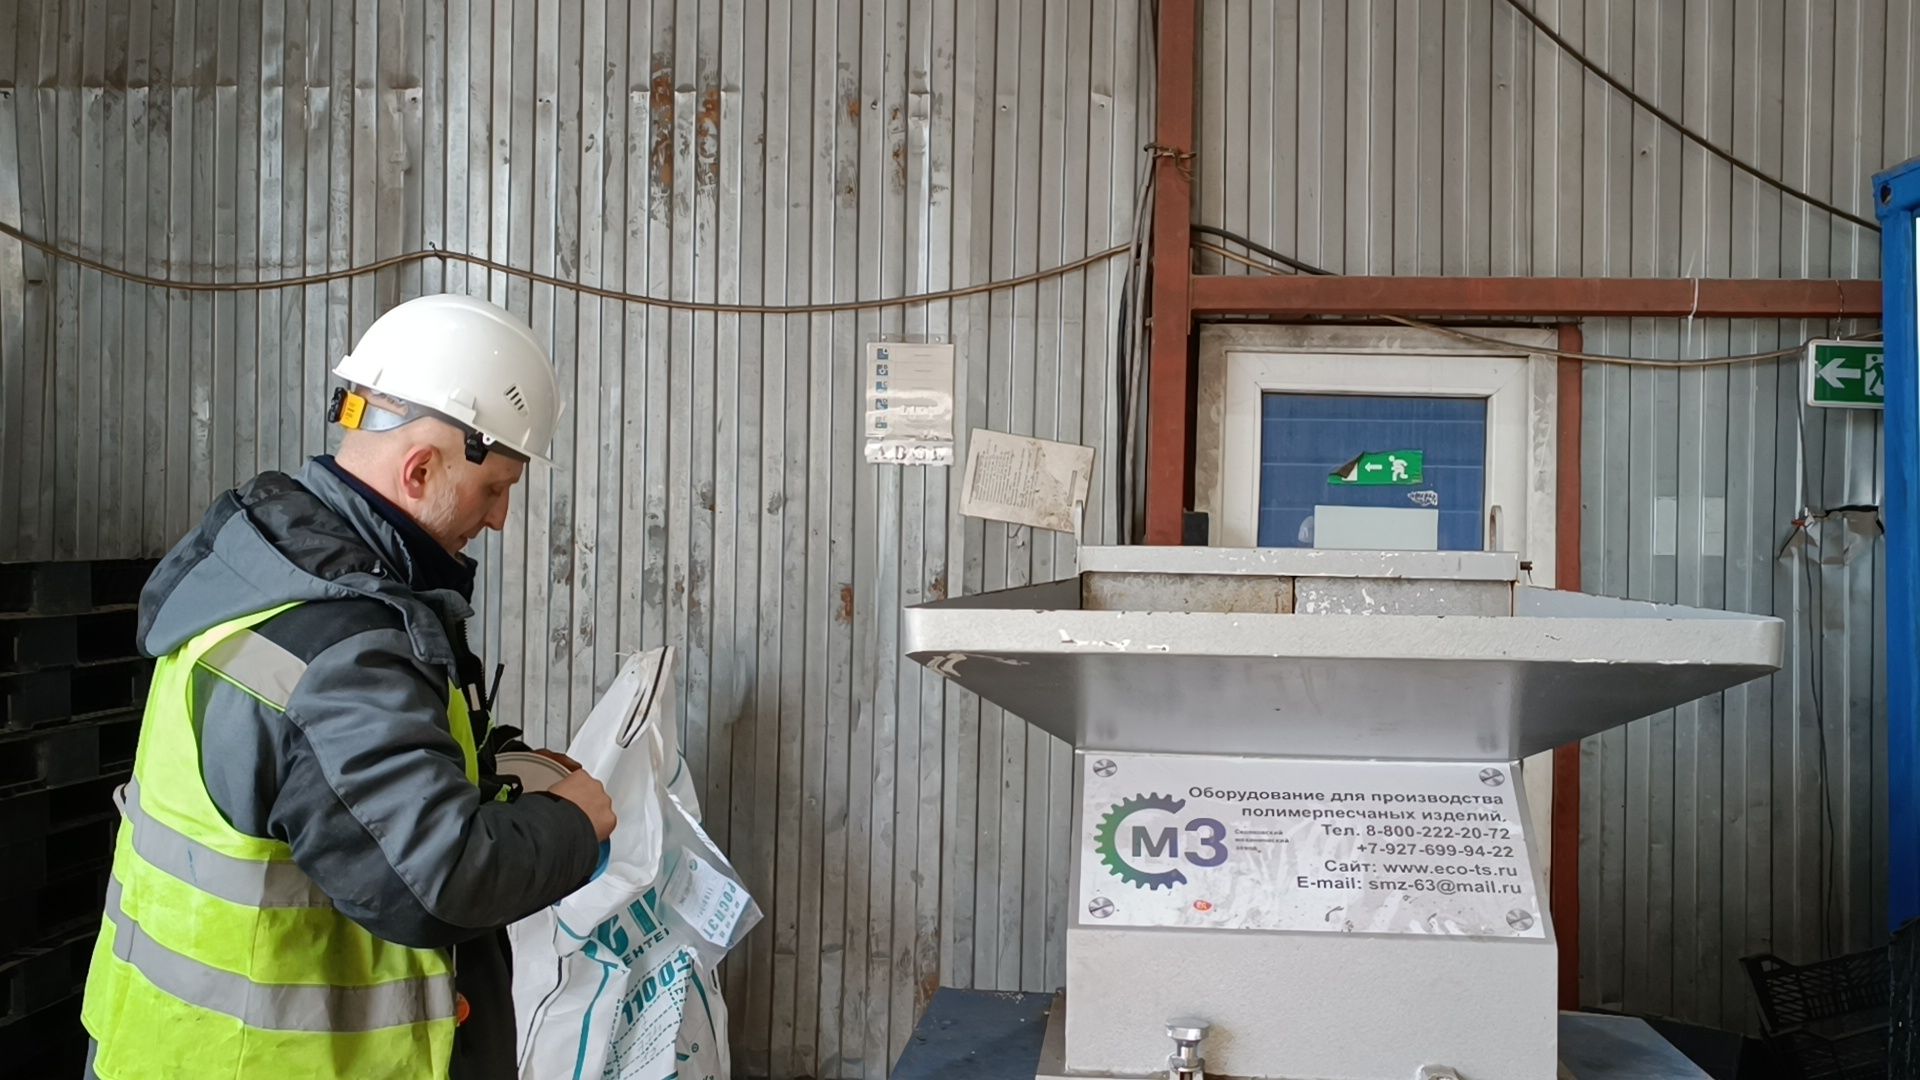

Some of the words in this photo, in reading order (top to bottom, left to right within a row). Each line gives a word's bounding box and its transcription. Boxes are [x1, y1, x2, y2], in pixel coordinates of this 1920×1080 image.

[1188, 786, 1325, 802] Оборудование
[1331, 791, 1365, 803] для
[1371, 792, 1504, 806] производства
[1241, 807, 1416, 821] полимерпесчаных
[1422, 809, 1507, 823] изделий.
[1321, 823, 1361, 837] Тел.
[1366, 824, 1511, 840] 8-800-222-20-72
[1357, 842, 1514, 858] +7-927-699-94-22
[1324, 859, 1378, 874] Сайт:
[1383, 862, 1518, 877] www.eco-ts.ru
[1296, 876, 1362, 891] E-mail:
[1368, 878, 1523, 896] smz-63@mail.ru
